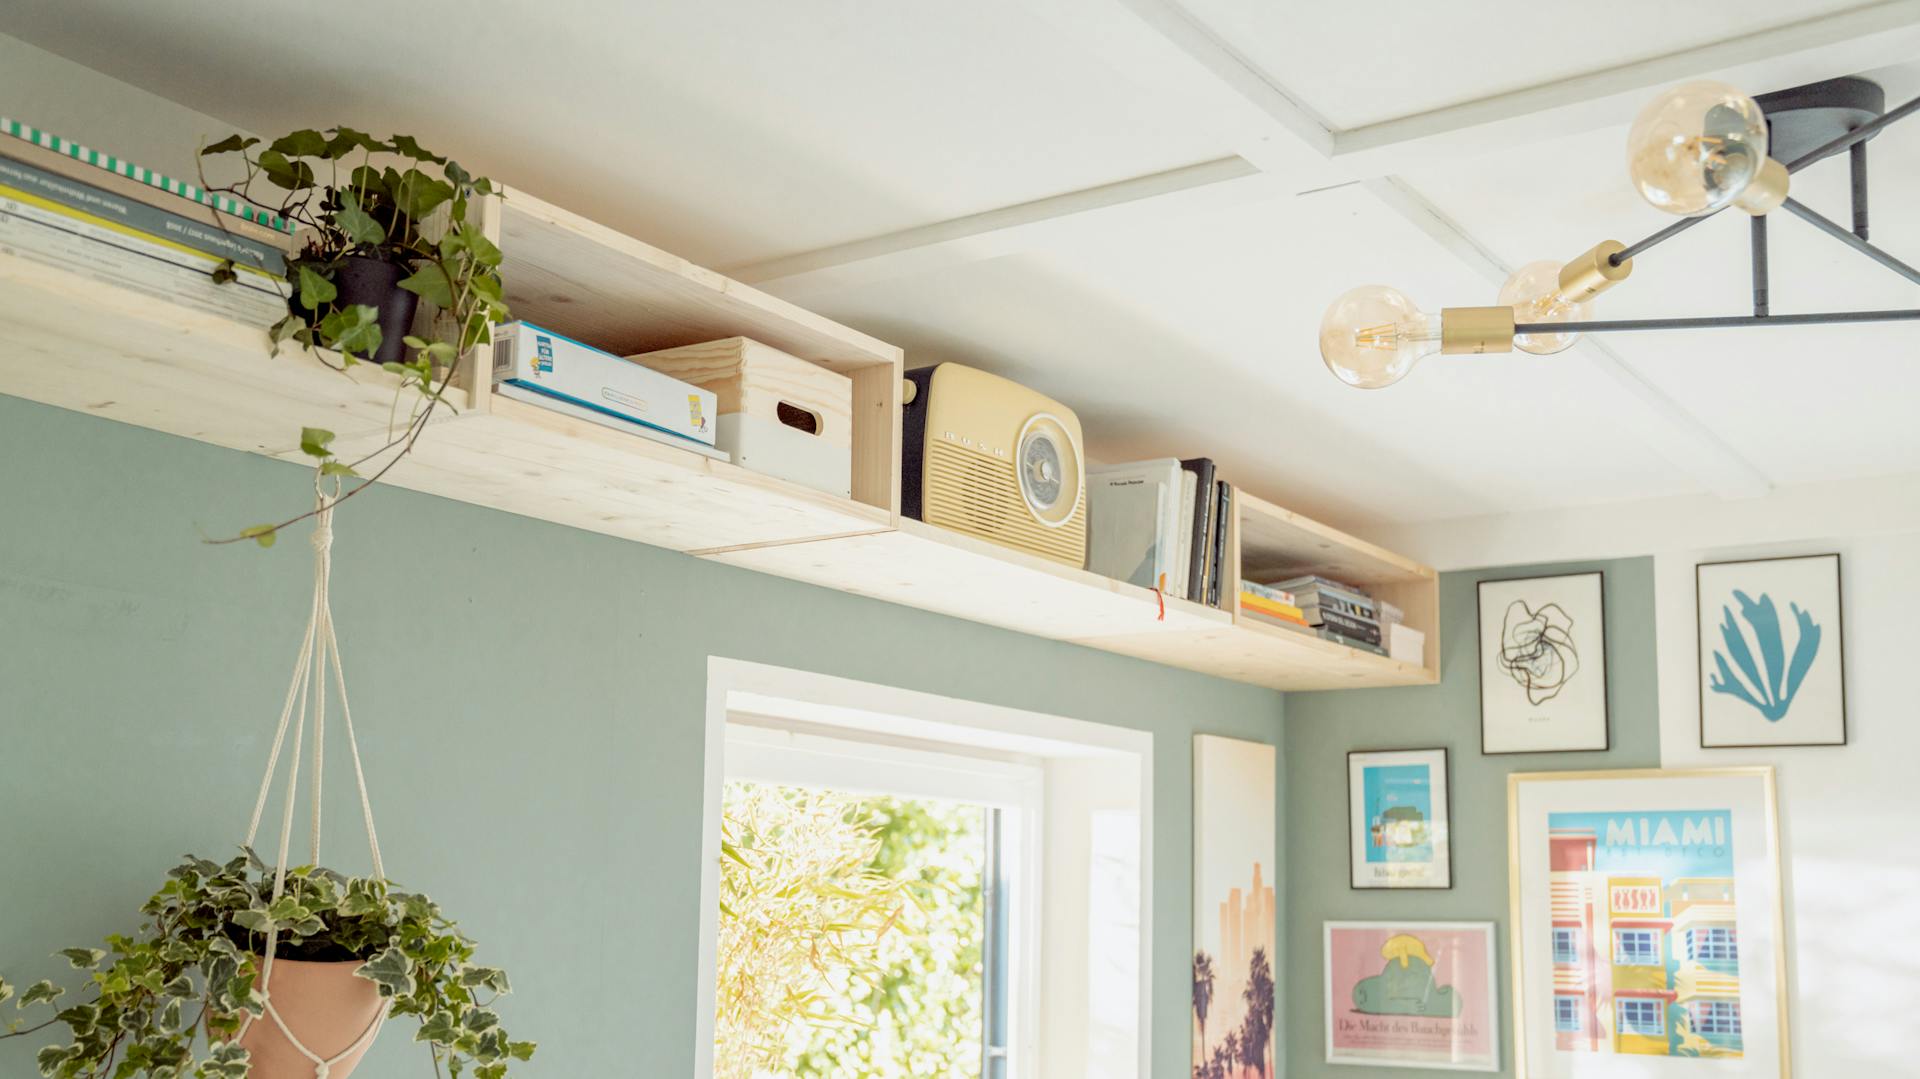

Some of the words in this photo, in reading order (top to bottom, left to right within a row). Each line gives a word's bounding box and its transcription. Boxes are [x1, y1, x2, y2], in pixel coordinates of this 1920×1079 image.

[1606, 817, 1725, 846] MIAMI
[1339, 1020, 1355, 1032] Die
[1360, 1020, 1389, 1033] Macht
[1392, 1022, 1408, 1034] des
